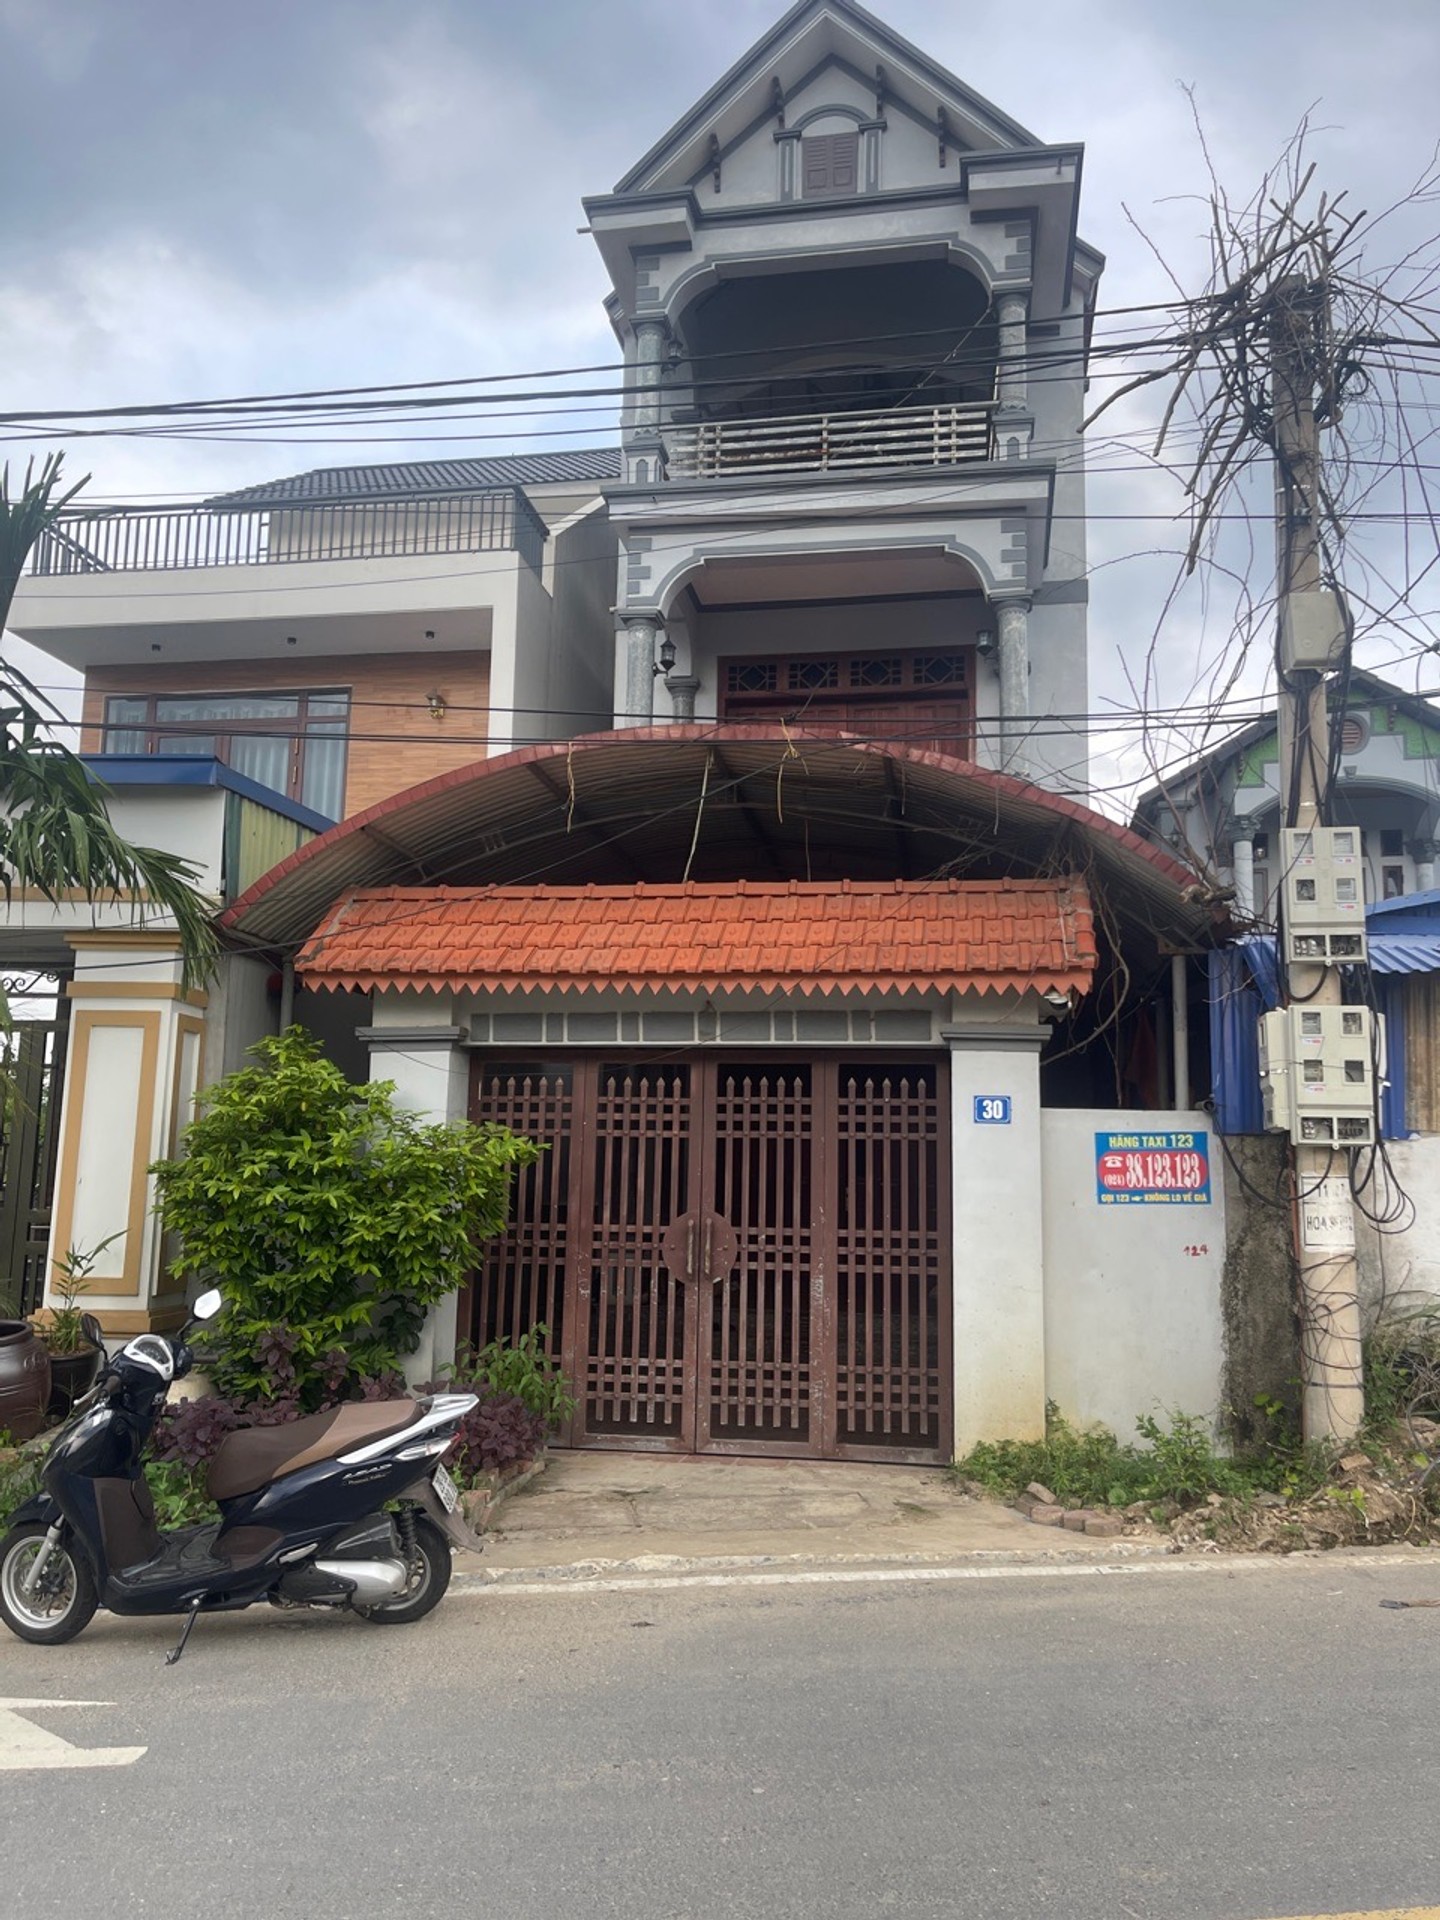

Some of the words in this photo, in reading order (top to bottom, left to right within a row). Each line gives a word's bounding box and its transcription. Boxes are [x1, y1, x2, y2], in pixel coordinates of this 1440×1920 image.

[982, 1099, 1003, 1119] 30
[1142, 1135, 1167, 1148] TAXI
[1170, 1134, 1194, 1148] 123
[1125, 1153, 1201, 1188] 38.123.123
